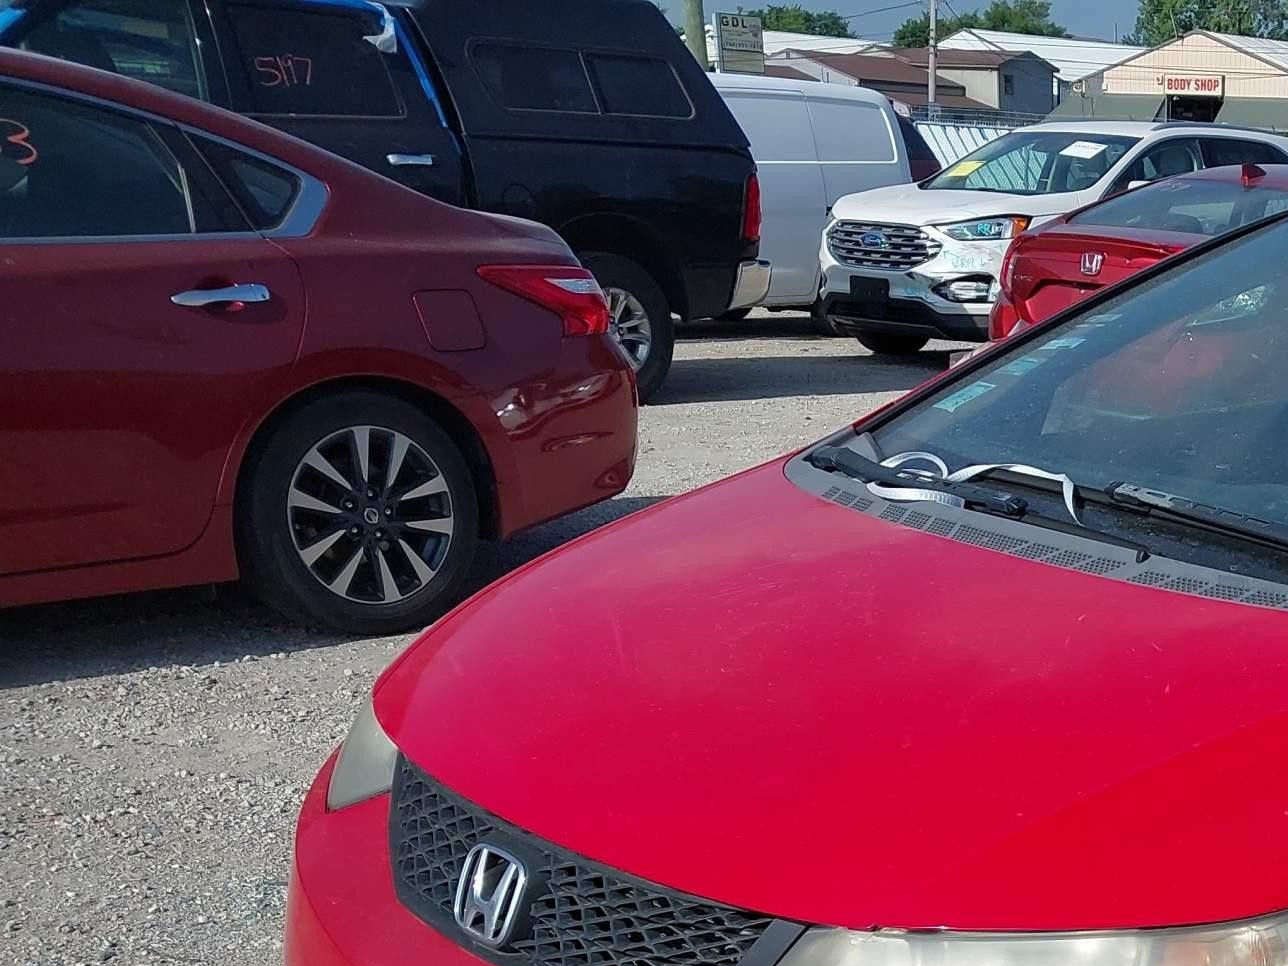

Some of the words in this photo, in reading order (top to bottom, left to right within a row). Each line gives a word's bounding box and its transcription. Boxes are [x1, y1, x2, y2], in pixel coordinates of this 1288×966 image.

[721, 16, 748, 29] GDL
[254, 53, 312, 88] 5197
[1167, 78, 1192, 91] BODY
[1194, 79, 1220, 92] SHOP
